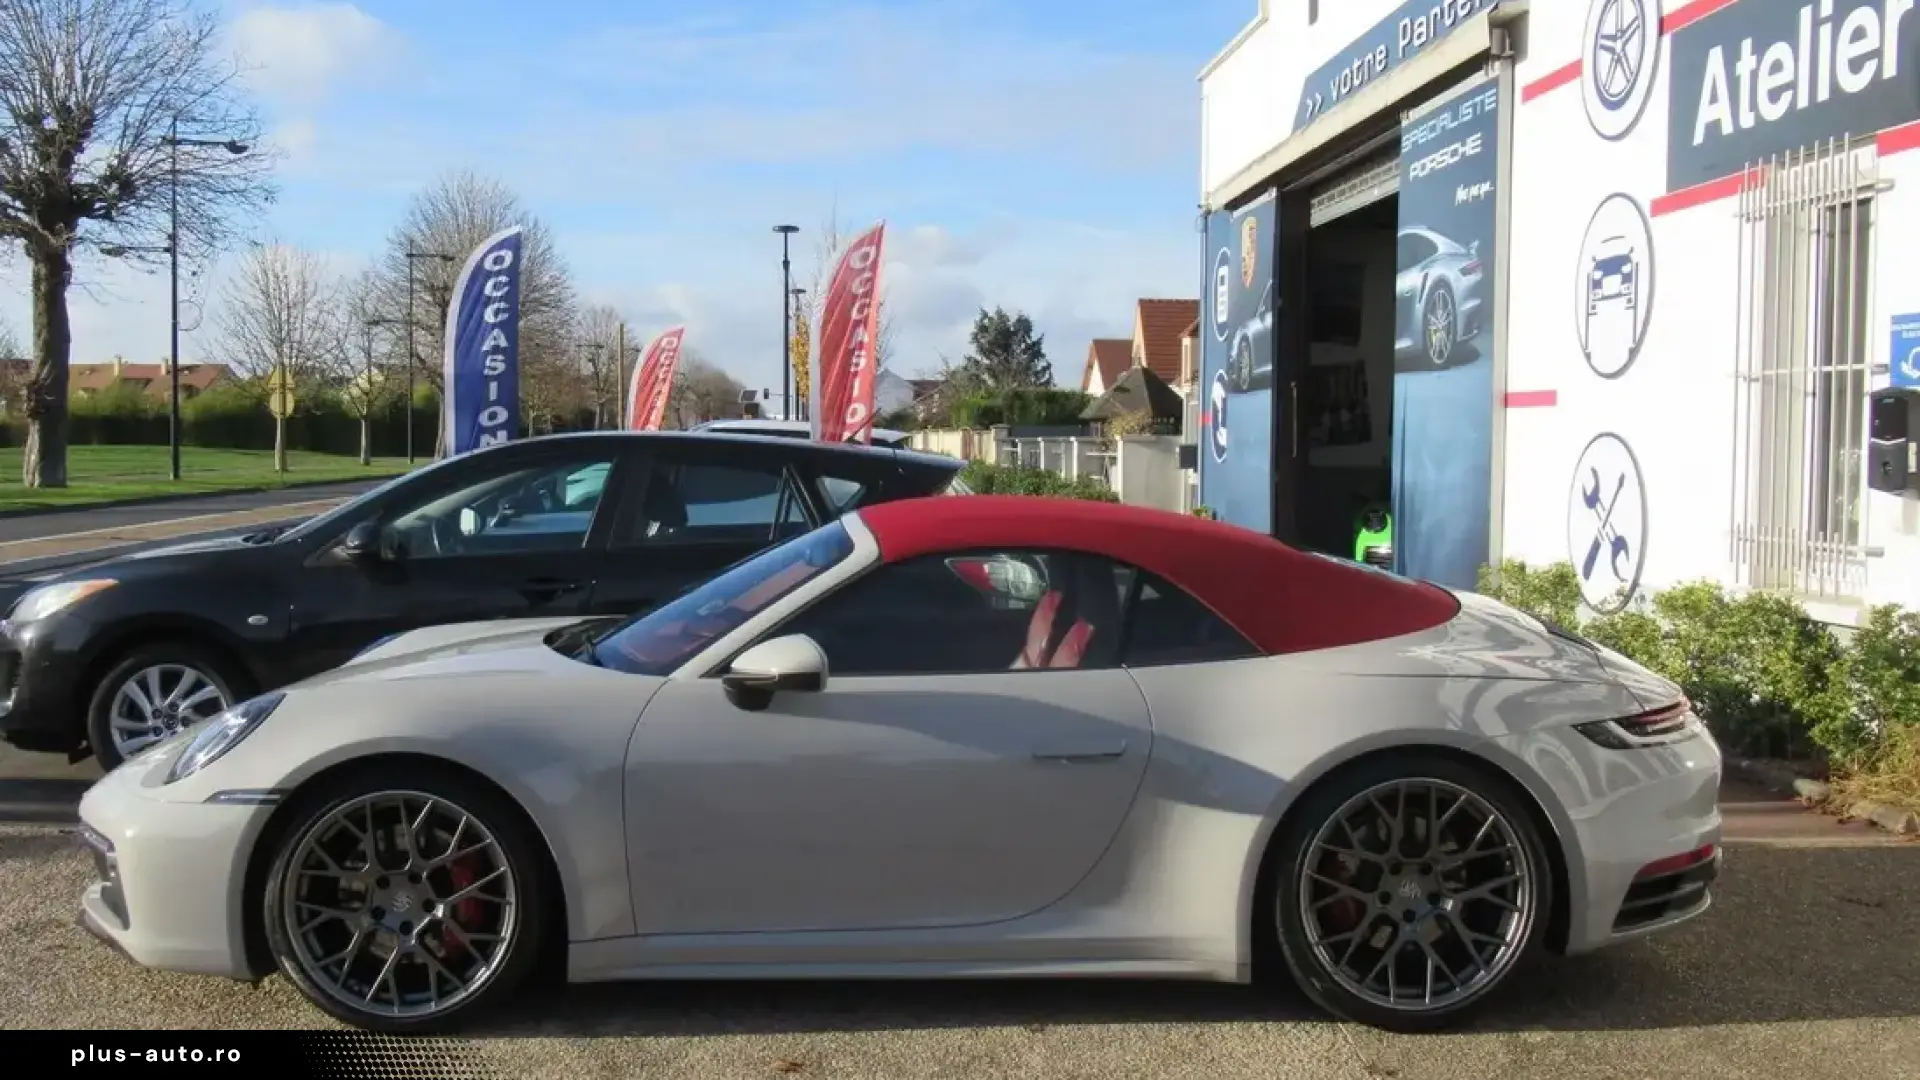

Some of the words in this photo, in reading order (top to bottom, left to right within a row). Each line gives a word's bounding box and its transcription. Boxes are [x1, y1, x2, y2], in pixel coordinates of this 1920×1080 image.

[1399, 0, 1482, 58] Parte
[1692, 0, 1914, 146] Atelier
[1401, 88, 1497, 153] SPECIALISTE
[1409, 131, 1482, 181] PORSCHE
